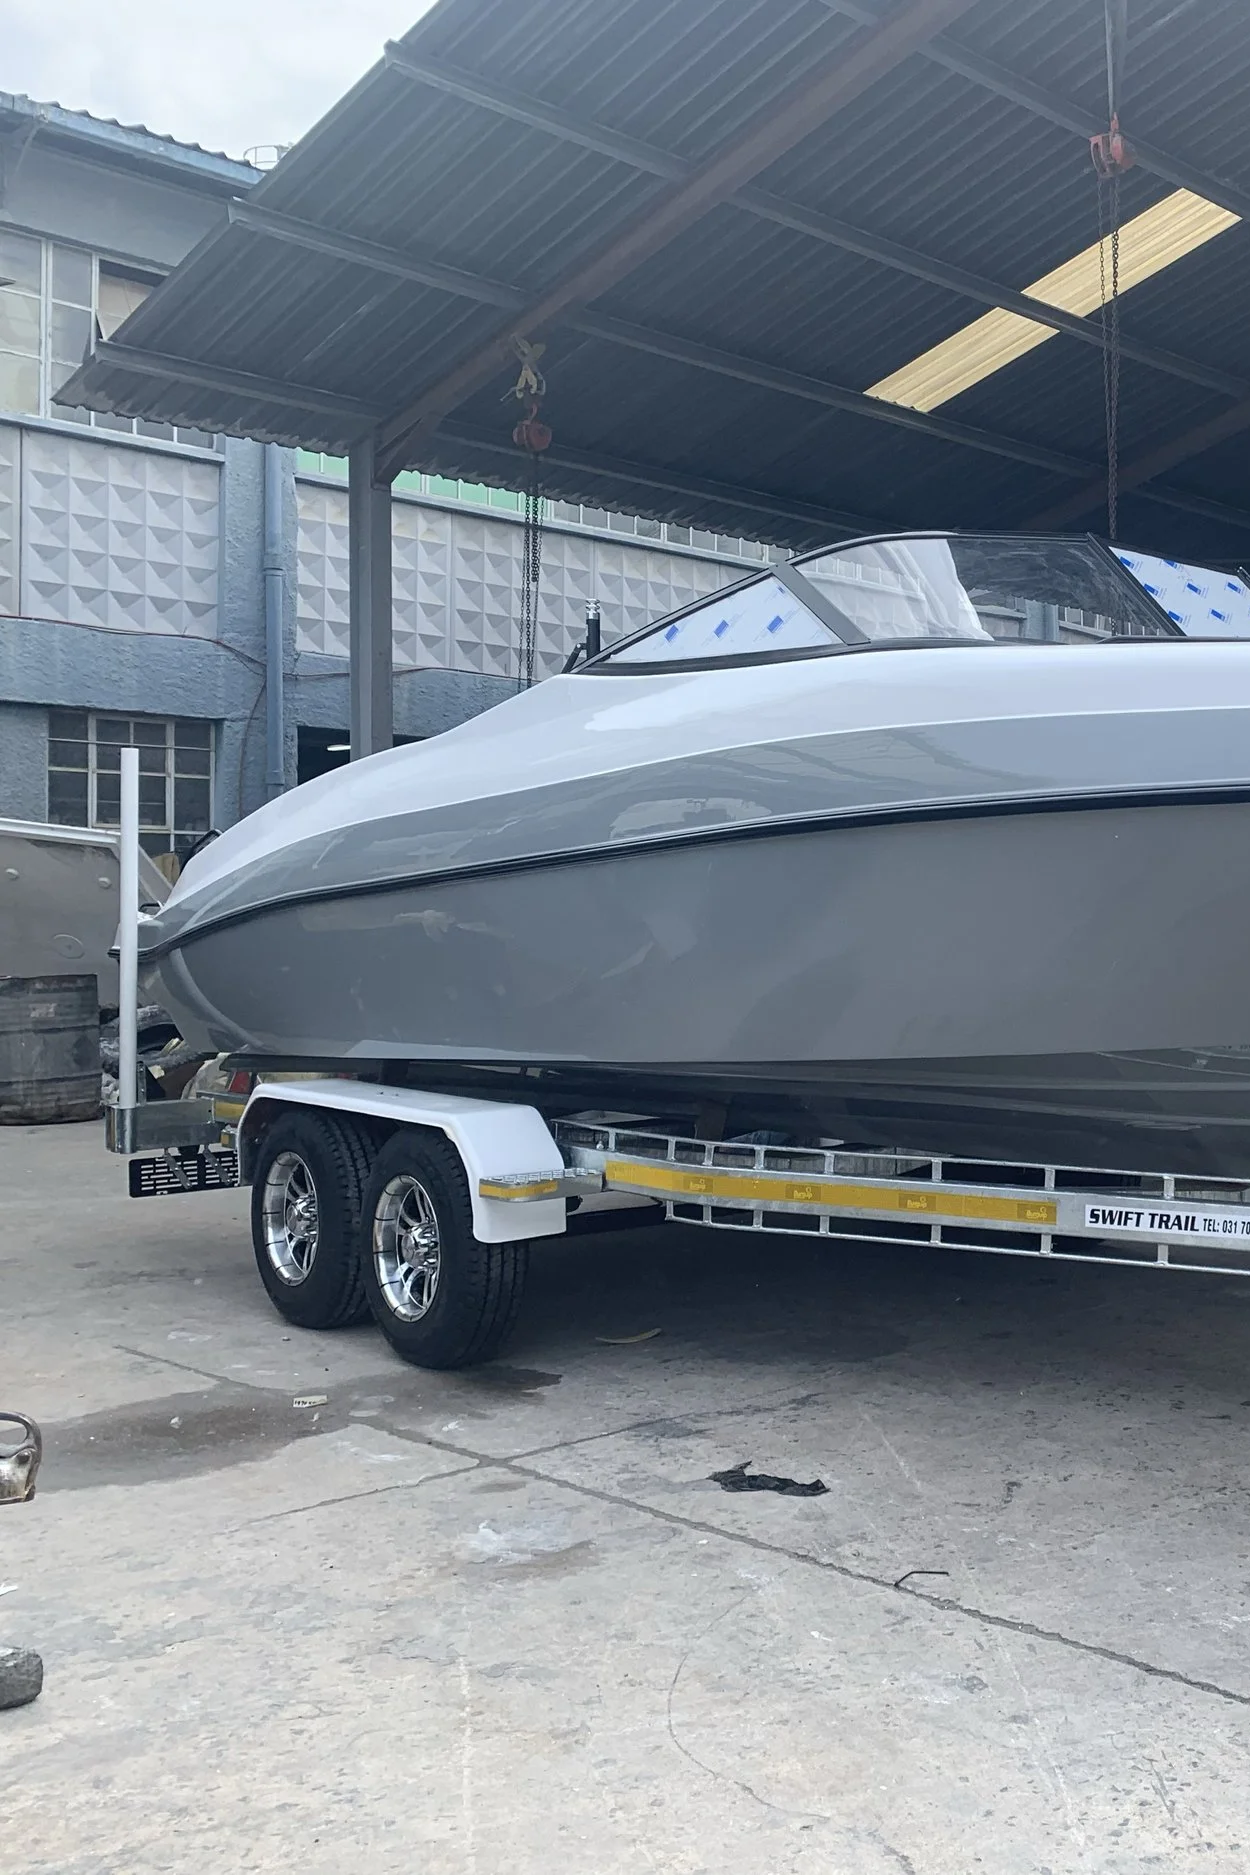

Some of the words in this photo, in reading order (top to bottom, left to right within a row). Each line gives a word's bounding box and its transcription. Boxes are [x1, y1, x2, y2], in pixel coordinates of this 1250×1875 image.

[1089, 1208, 1145, 1228] SWIFT
[1148, 1212, 1199, 1232] TRAIL
[1203, 1218, 1219, 1232] TEL:
[1222, 1220, 1238, 1234] 031
